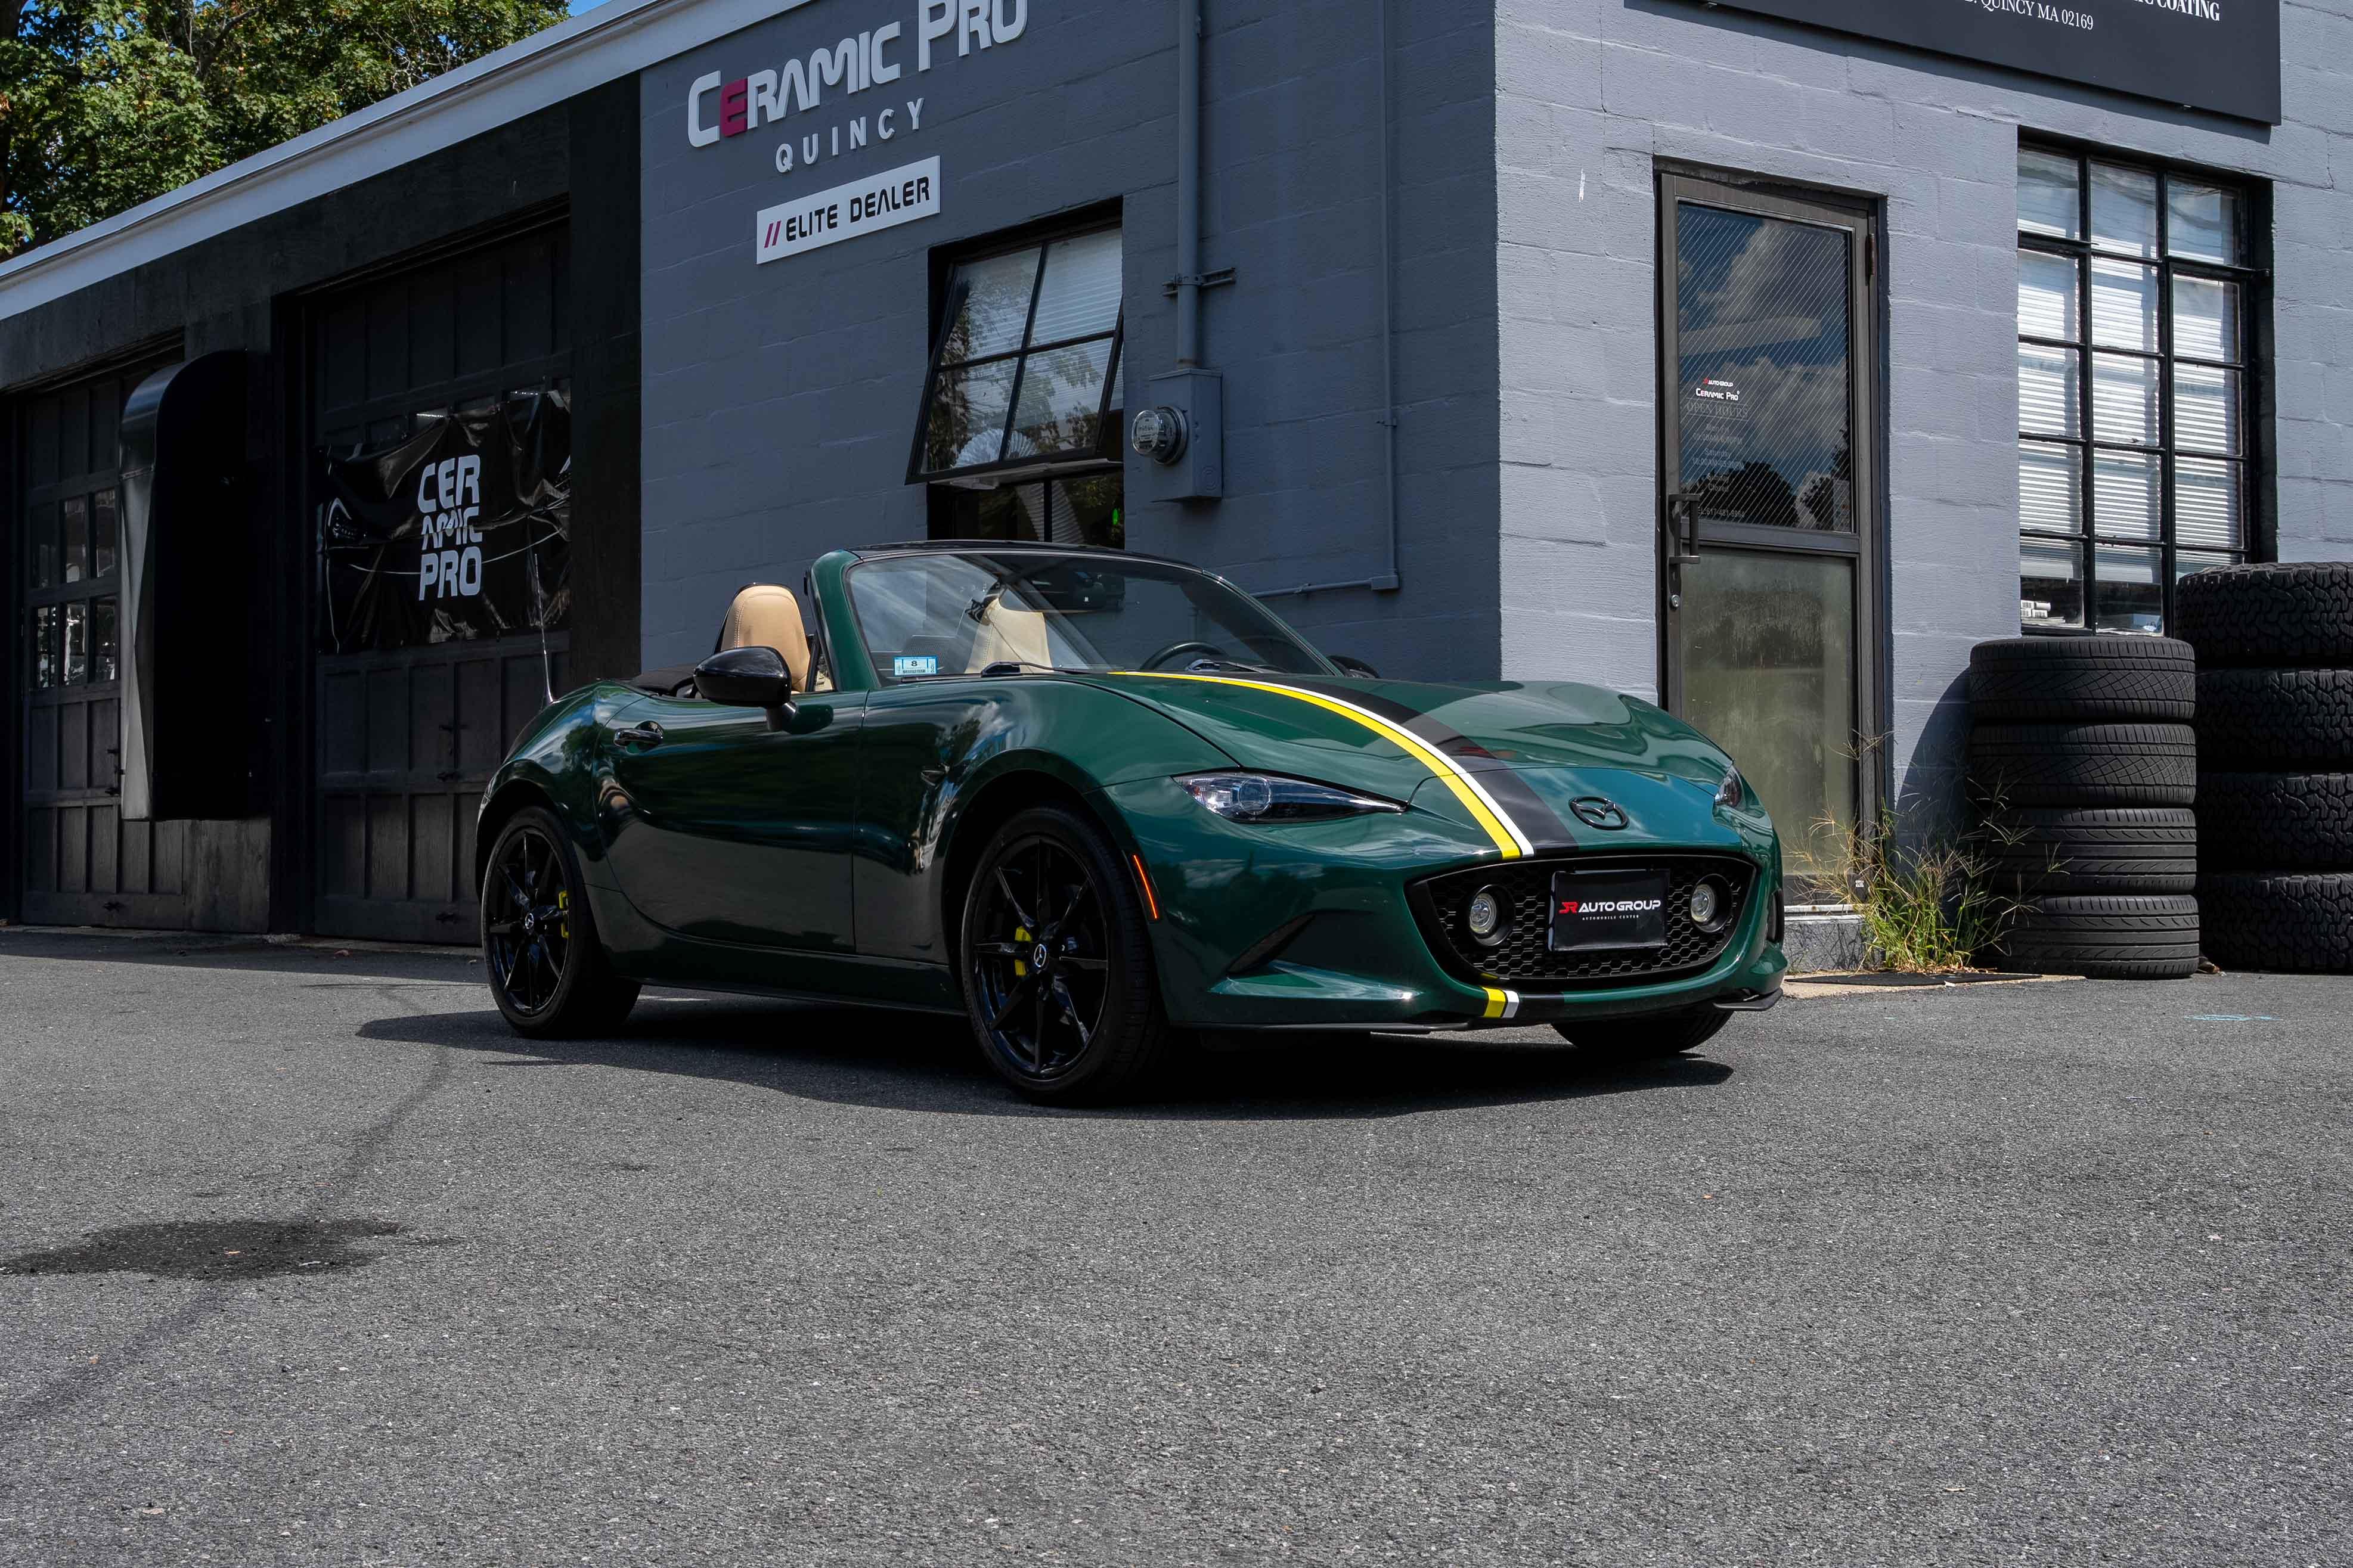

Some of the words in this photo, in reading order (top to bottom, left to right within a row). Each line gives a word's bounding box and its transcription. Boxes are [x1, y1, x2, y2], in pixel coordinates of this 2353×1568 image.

[2037, 2, 2059, 23] MA
[2061, 9, 2094, 30] 02169
[687, 21, 901, 148] CERAMIC
[918, 0, 1028, 72] PRO
[775, 98, 925, 174] QUINCY
[850, 176, 931, 222] DEALER
[1695, 387, 1724, 400] CERAMIC
[1726, 391, 1738, 401] PRO
[418, 454, 481, 514] CER
[418, 546, 482, 601] PRO
